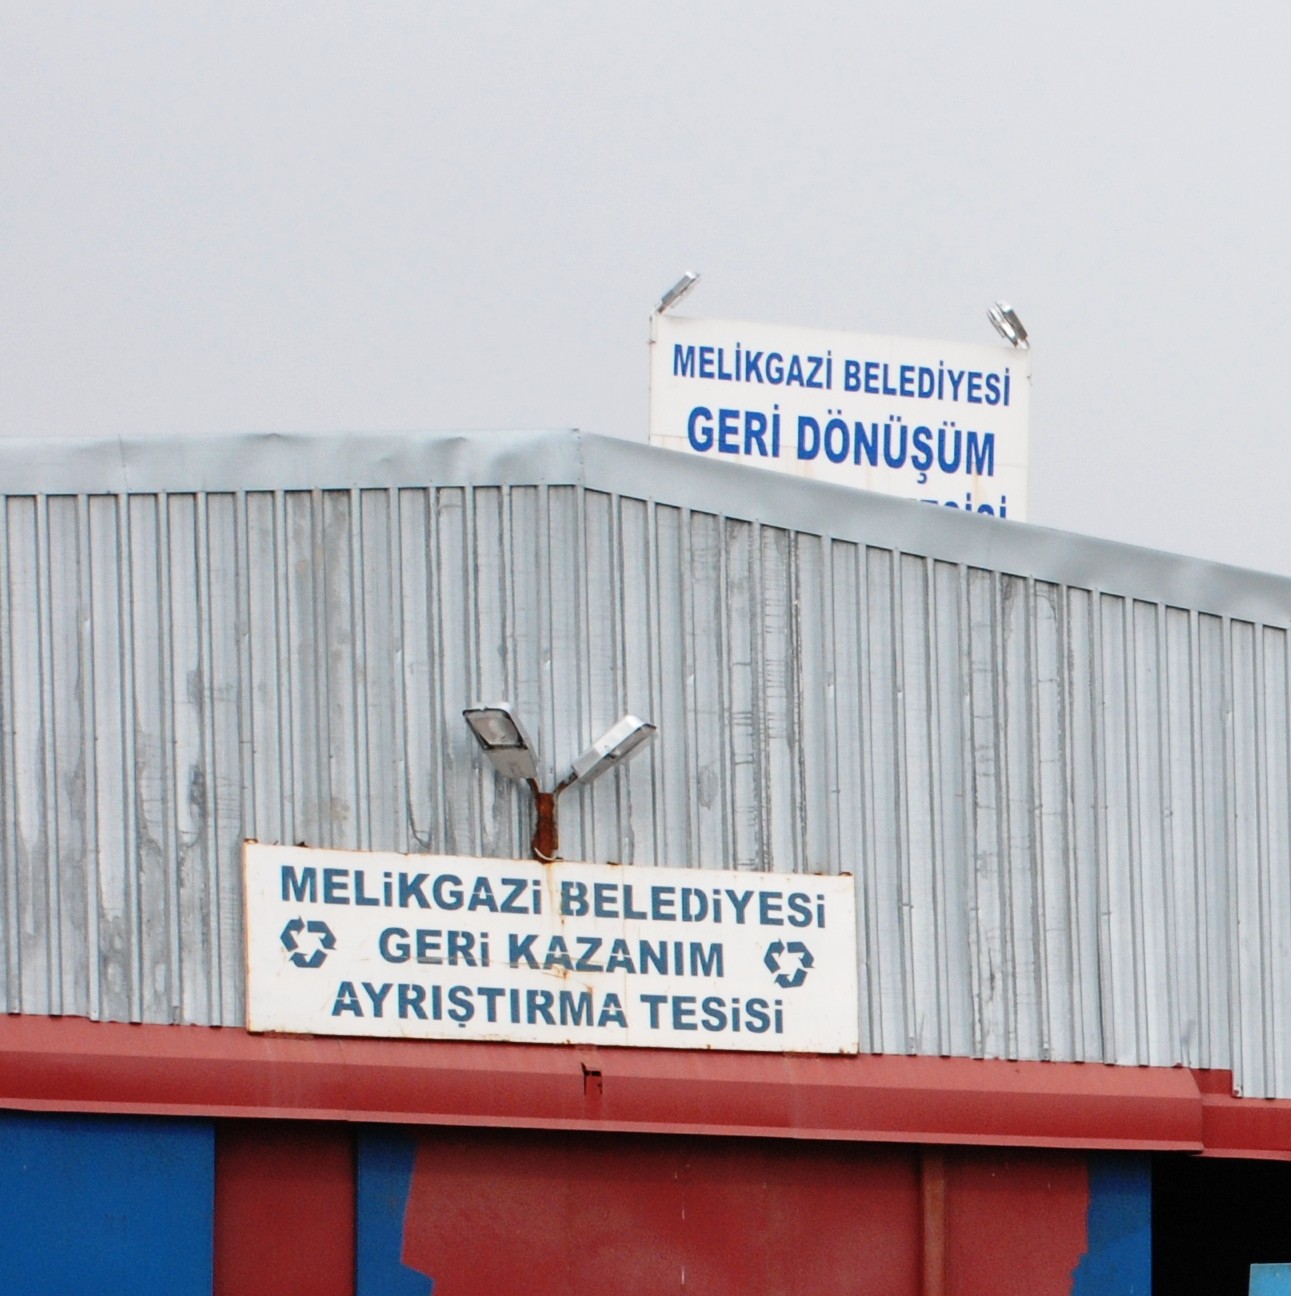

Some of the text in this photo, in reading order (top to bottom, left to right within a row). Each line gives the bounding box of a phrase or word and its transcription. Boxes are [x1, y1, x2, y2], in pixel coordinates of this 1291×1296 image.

[673, 341, 1011, 407] MELİKGAZİ BELEDİYESİ
[687, 403, 996, 485] GERİ DÖNÜŞÜM
[508, 933, 725, 978] KAZANIM
[331, 980, 629, 1029] AYRIŞTIRMA
